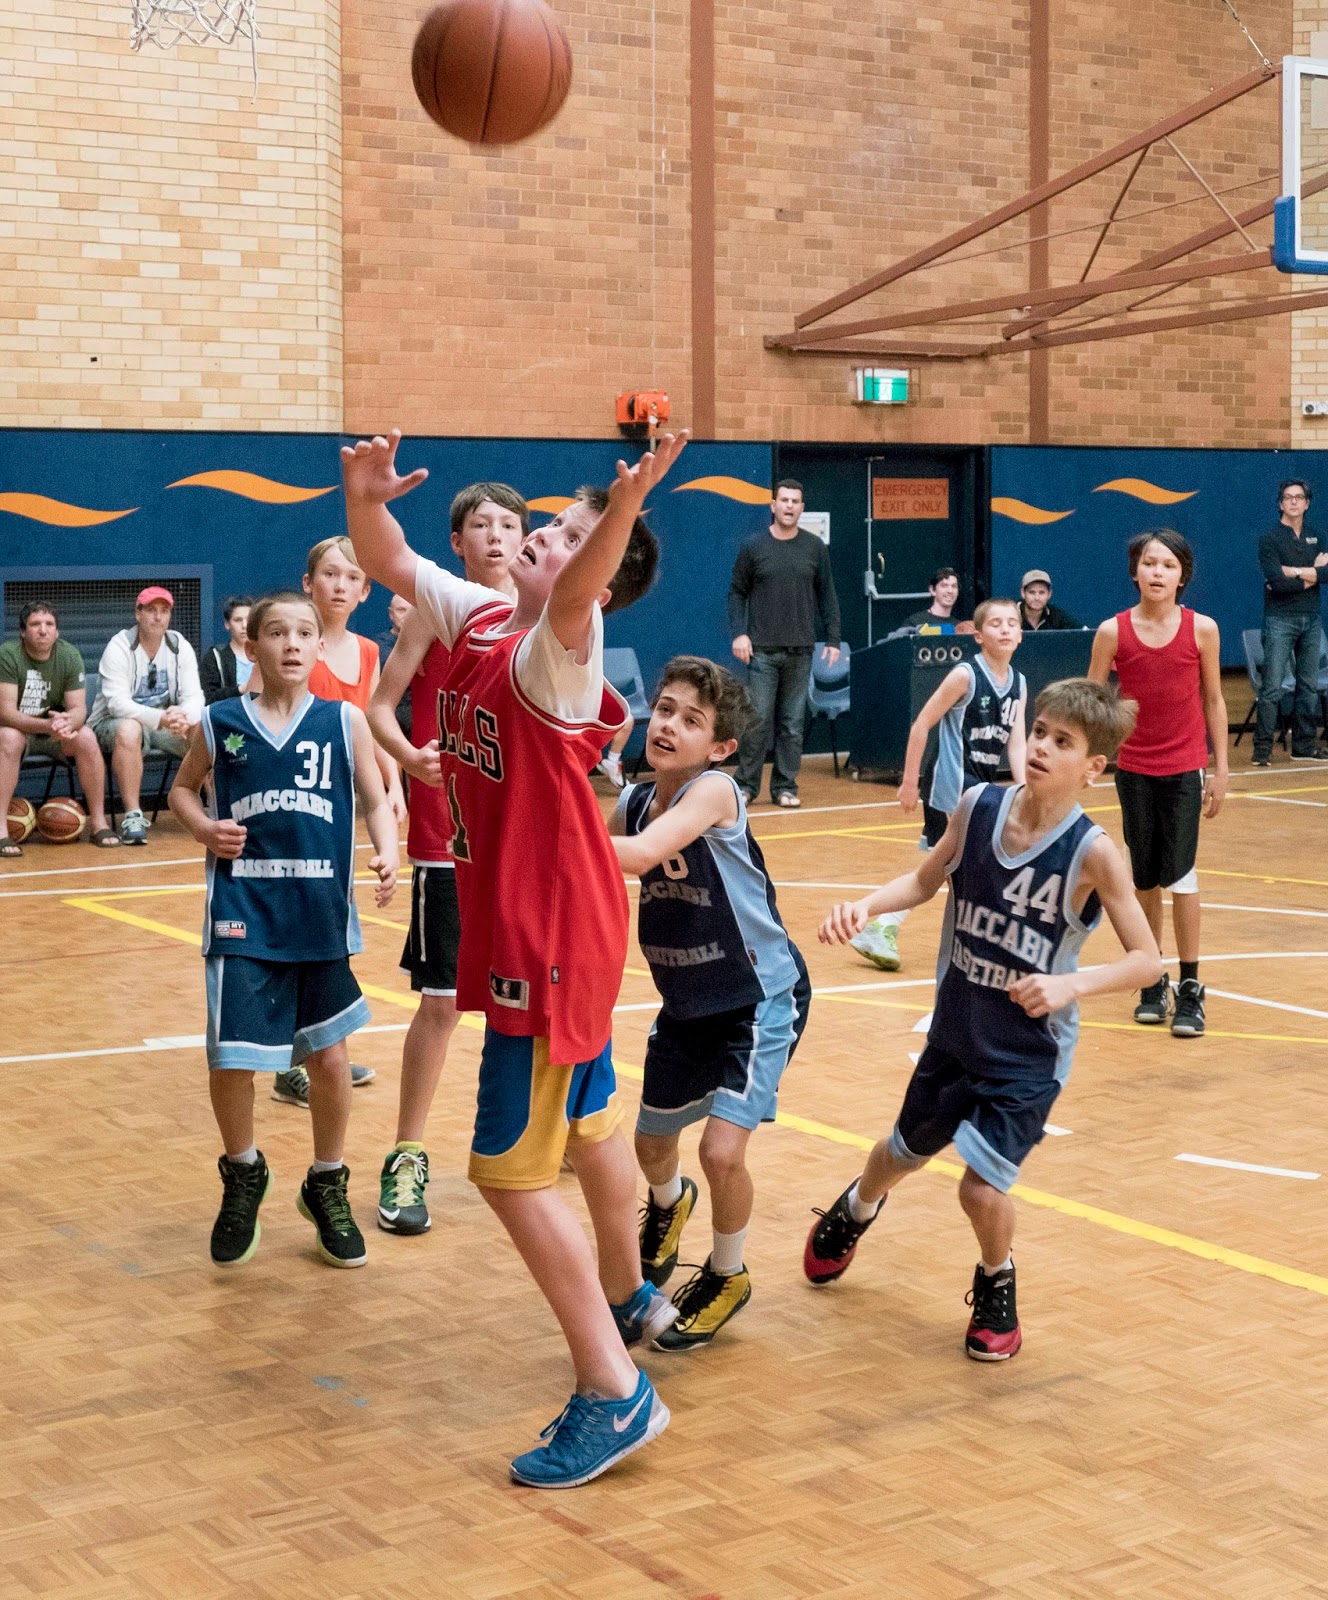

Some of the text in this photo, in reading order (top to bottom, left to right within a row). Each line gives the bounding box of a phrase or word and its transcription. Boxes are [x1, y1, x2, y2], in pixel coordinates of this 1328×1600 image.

[874, 484, 948, 496] EMERGENCY
[881, 500, 941, 512] EXIT ONLY
[294, 740, 332, 789] 31
[230, 789, 334, 824] MACCABI
[231, 859, 334, 878] BASKETBALL
[640, 880, 712, 907] CCABI
[1002, 866, 1062, 925] 44
